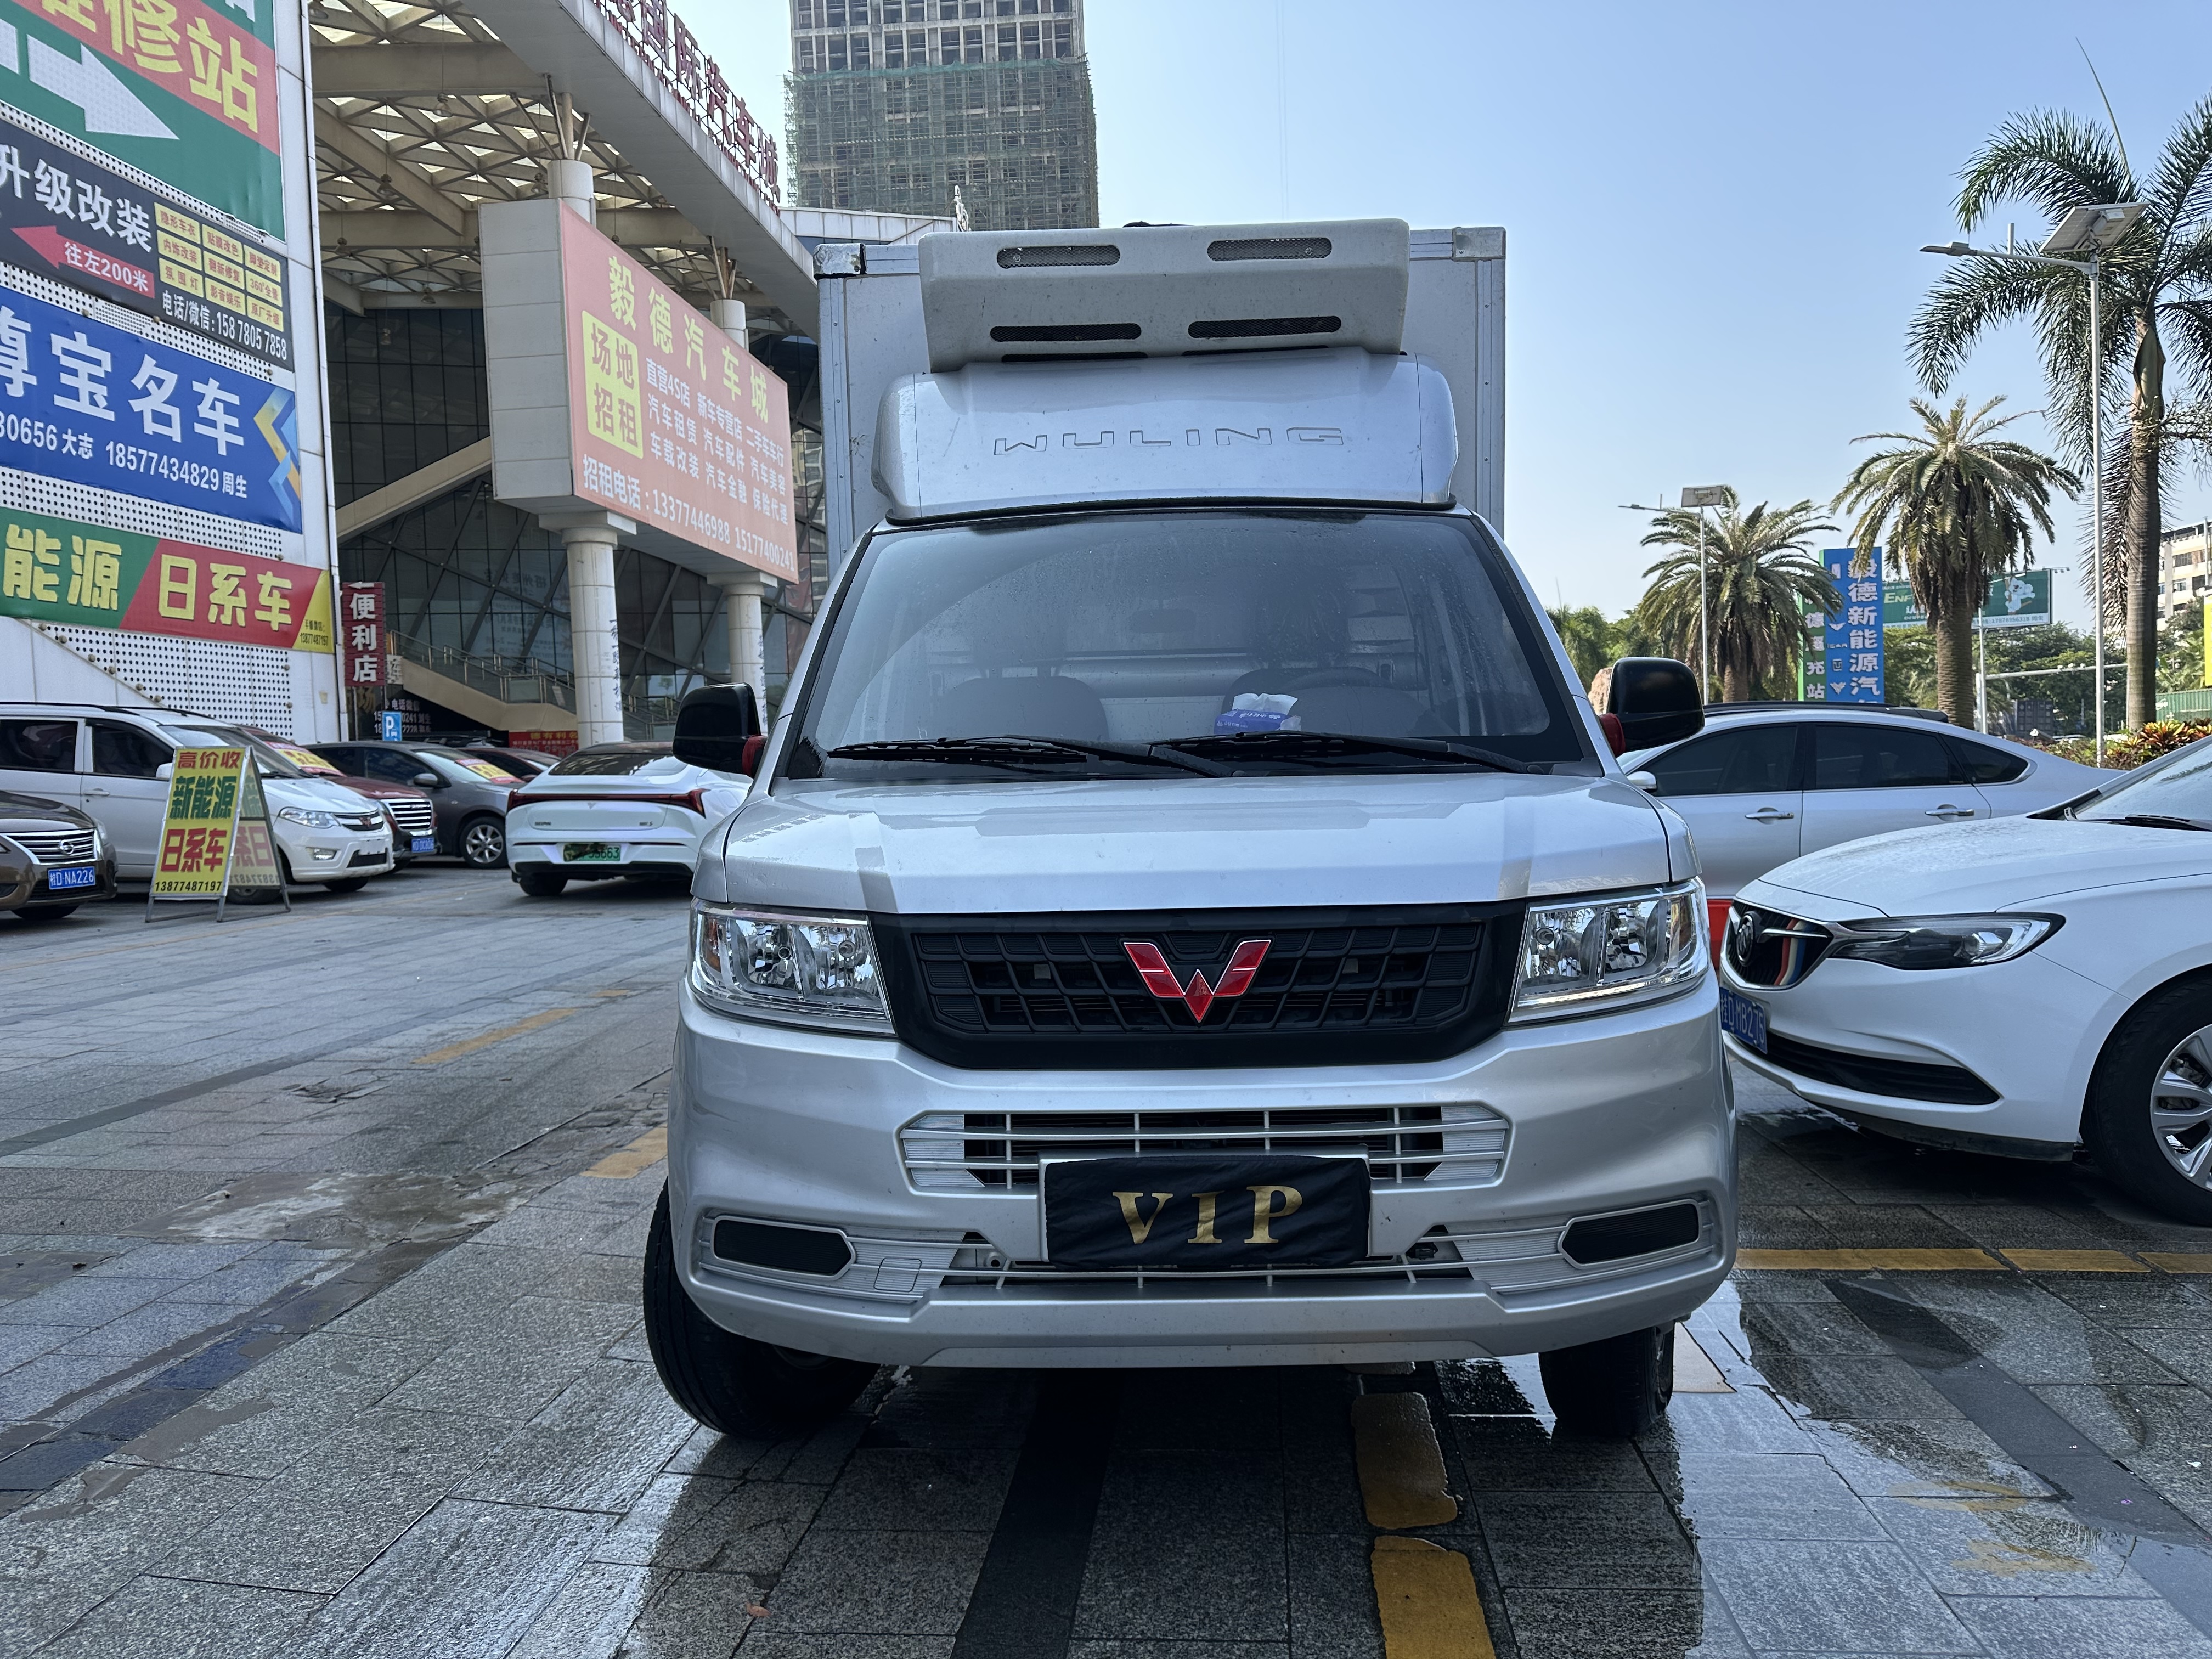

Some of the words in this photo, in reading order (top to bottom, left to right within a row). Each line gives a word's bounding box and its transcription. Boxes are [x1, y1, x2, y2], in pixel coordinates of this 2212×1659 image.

[616, 0, 780, 202] 国际汽车城
[0, 144, 152, 253] 升级改装
[64, 241, 148, 292] 往左200米
[163, 238, 198, 264] 内饰改装
[591, 322, 635, 390] 场地
[593, 382, 639, 448] 招租
[646, 357, 690, 409] 直营4S店
[697, 391, 742, 442] 新车专营店
[61, 428, 93, 460] 大志
[105, 441, 219, 491] 18577434829
[222, 471, 247, 499] 周生
[648, 393, 697, 447] 汽车租赁
[703, 427, 745, 473] 汽车配件
[994, 427, 1344, 455] WULING
[2, 524, 122, 611] 能源
[158, 554, 293, 631] 日系车
[349, 592, 378, 682] 便利店
[386, 716, 394, 737] P
[177, 751, 241, 769] 高价收
[169, 775, 237, 819] 新能源
[160, 827, 227, 872] 日系车
[155, 881, 222, 891] 13877487197
[1112, 1185, 1303, 1245] VIP
